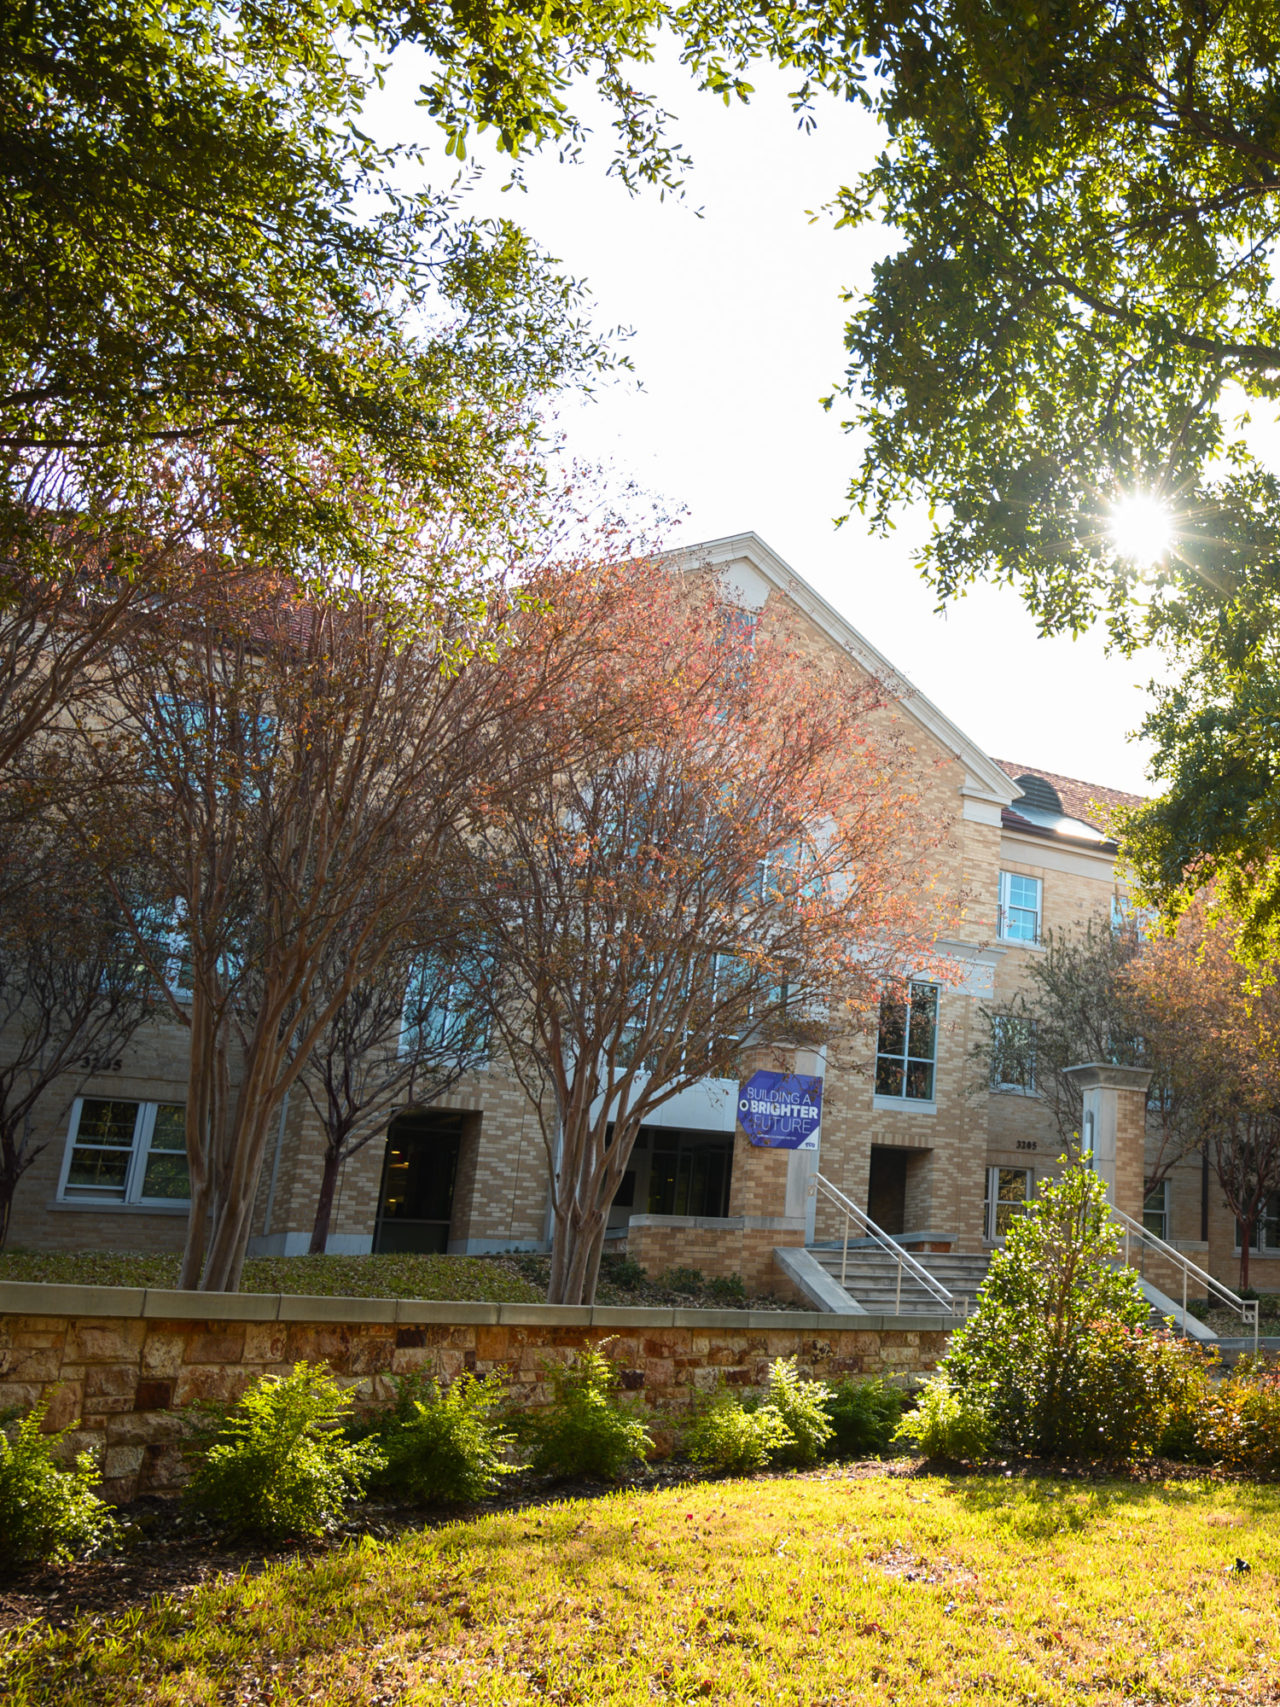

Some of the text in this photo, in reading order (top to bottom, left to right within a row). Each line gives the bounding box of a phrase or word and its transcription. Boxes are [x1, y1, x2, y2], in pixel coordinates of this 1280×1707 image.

[747, 1087, 812, 1105] BUILDING A
[750, 1100, 819, 1119] BRIGHTER
[754, 1114, 811, 1133] FUTURE
